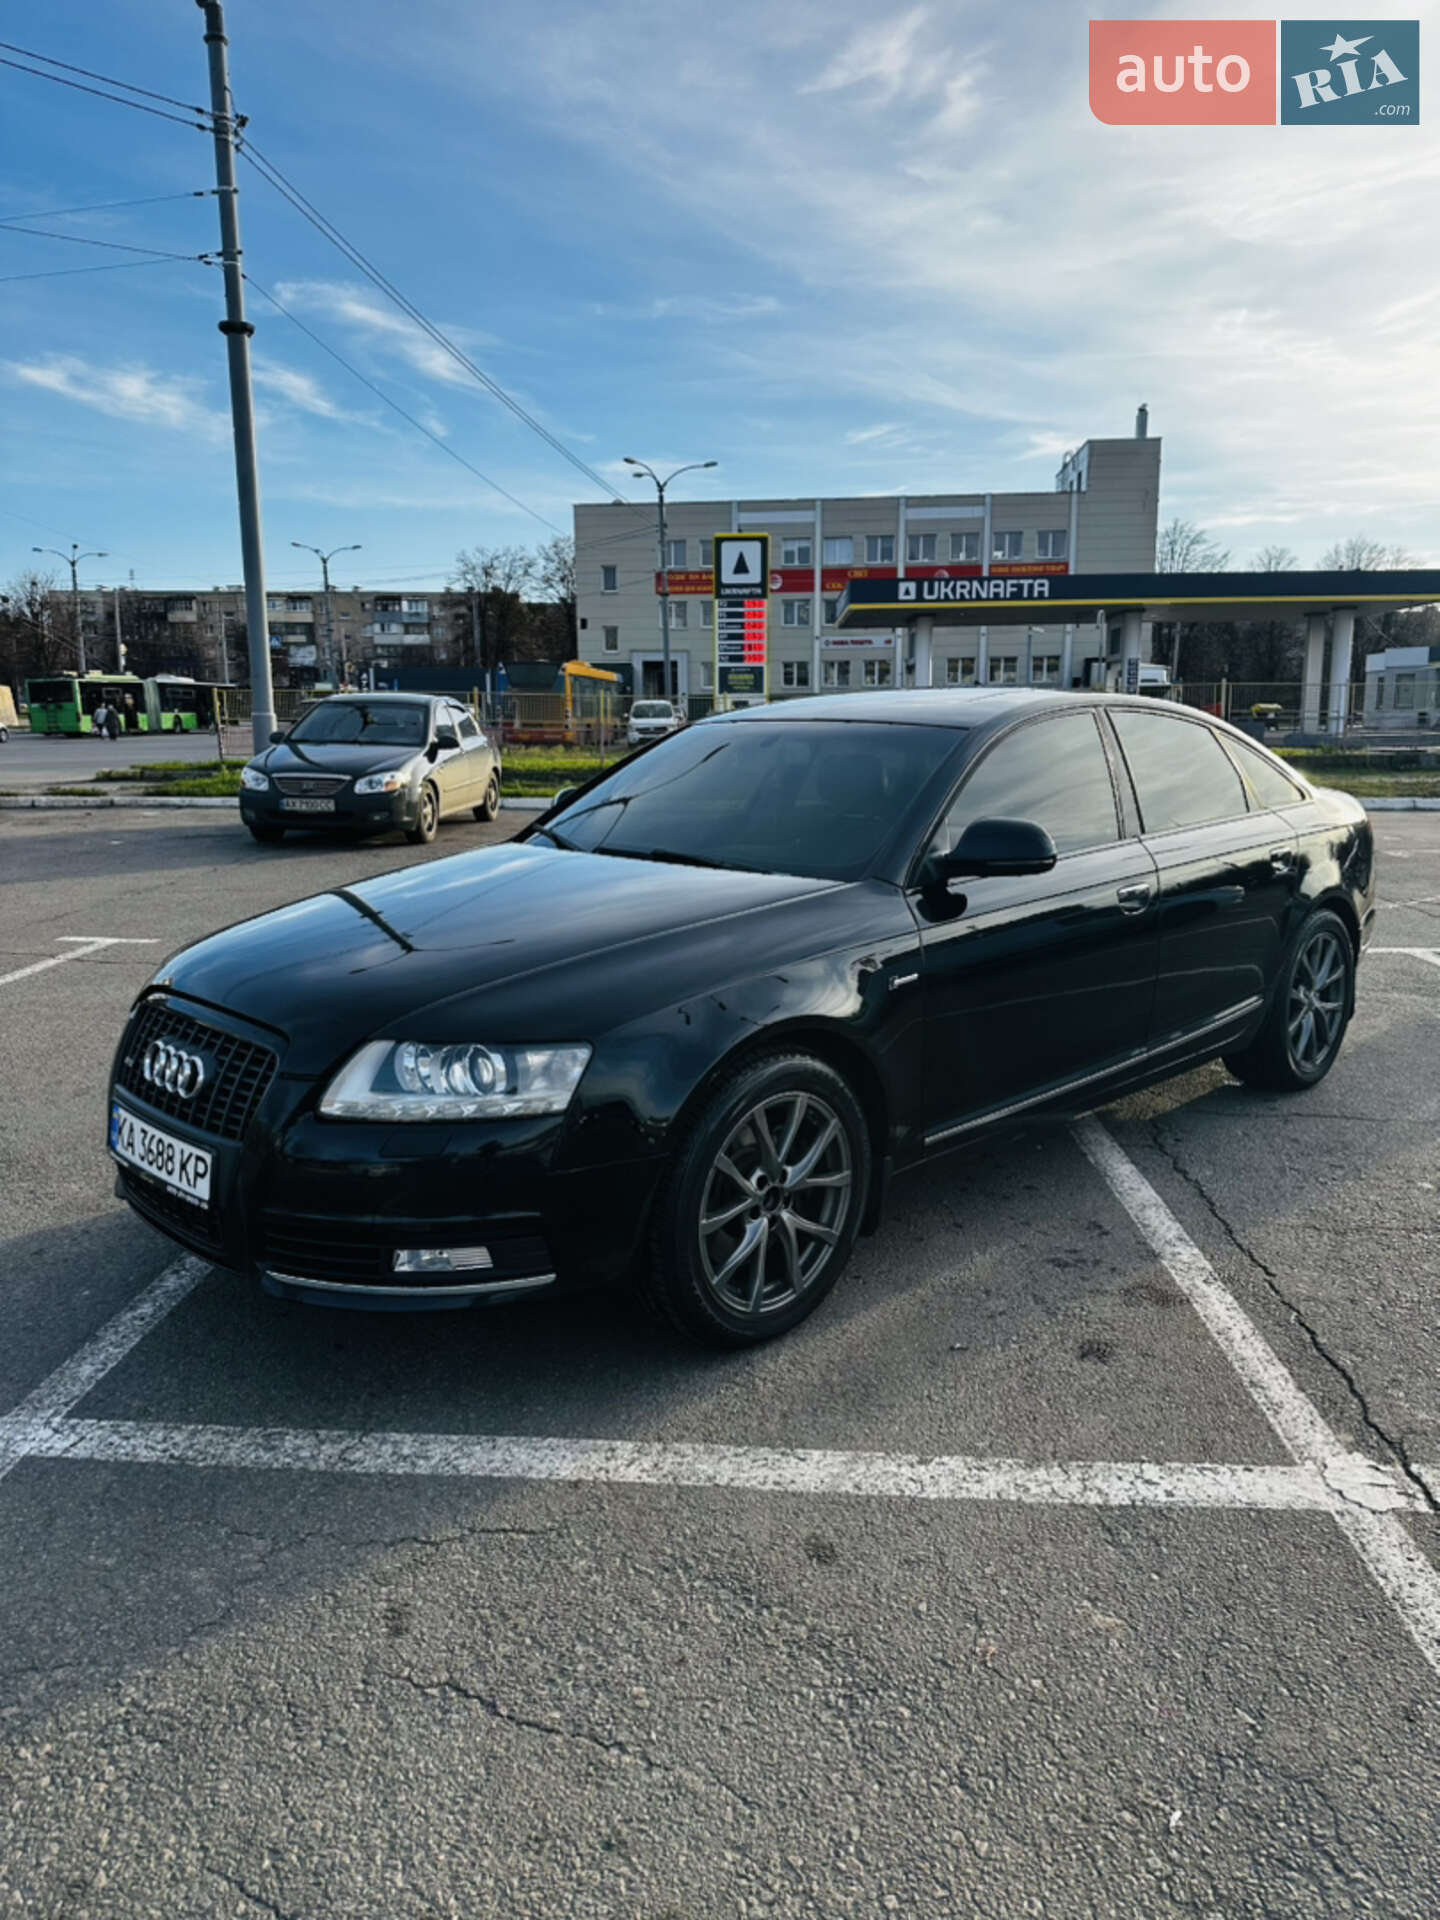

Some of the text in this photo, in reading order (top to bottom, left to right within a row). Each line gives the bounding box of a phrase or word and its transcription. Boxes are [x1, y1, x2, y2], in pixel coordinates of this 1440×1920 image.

[923, 579, 1049, 600] UKRNAFTA
[118, 1115, 209, 1189] KA 3688 KP
